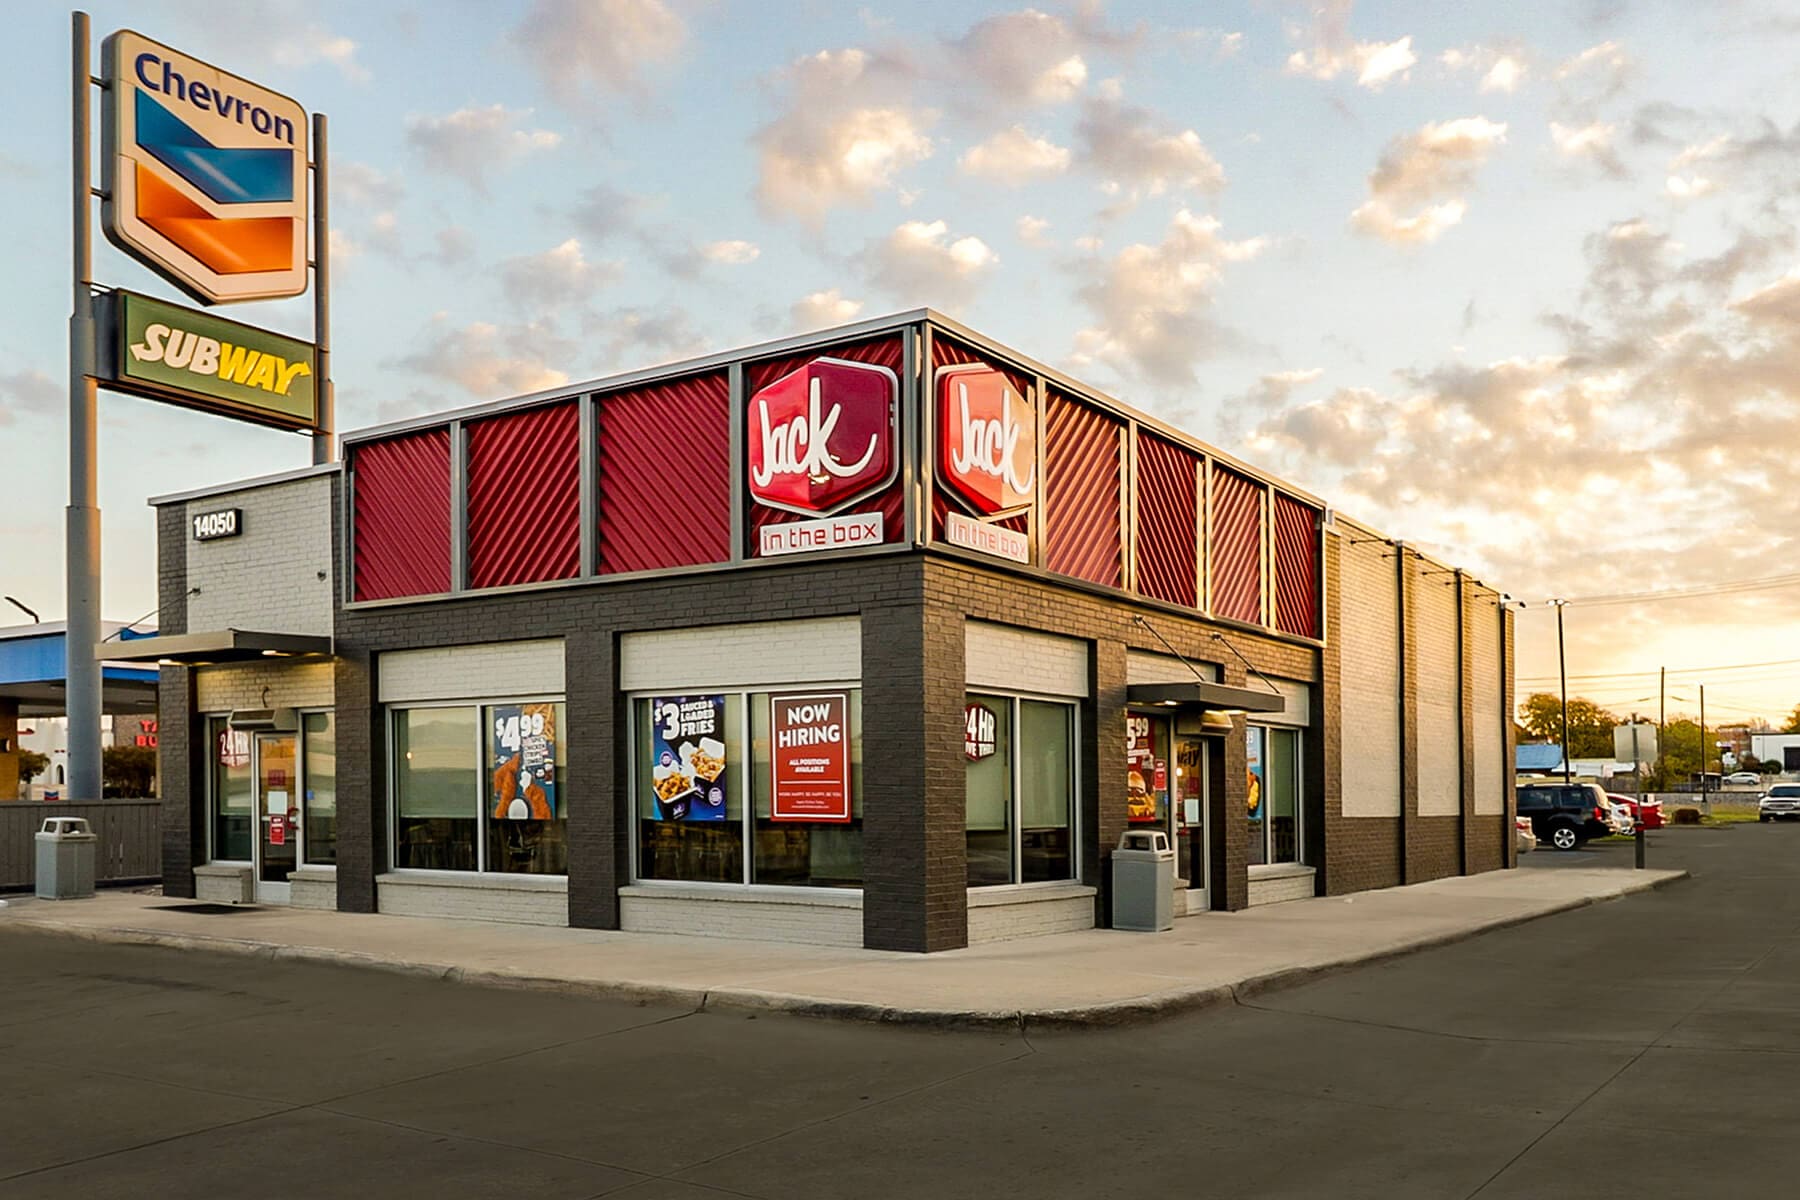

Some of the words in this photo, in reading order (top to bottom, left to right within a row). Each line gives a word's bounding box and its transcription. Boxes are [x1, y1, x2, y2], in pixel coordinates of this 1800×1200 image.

[135, 52, 294, 145] Chevron
[130, 323, 312, 396] SUBWAY
[753, 377, 878, 487] Jack
[952, 382, 1035, 494] Jack
[193, 511, 236, 537] 14050
[763, 530, 783, 550] in
[789, 527, 826, 548] the
[832, 523, 877, 543] box
[950, 518, 968, 543] in
[968, 523, 997, 551] the
[998, 531, 1027, 557] box
[655, 703, 680, 740] $3
[680, 709, 714, 722] LOADED
[681, 720, 714, 736] FRIES
[788, 703, 830, 726] NOW
[965, 708, 977, 742] 4
[978, 707, 995, 743] HR
[779, 724, 840, 748] HIRING
